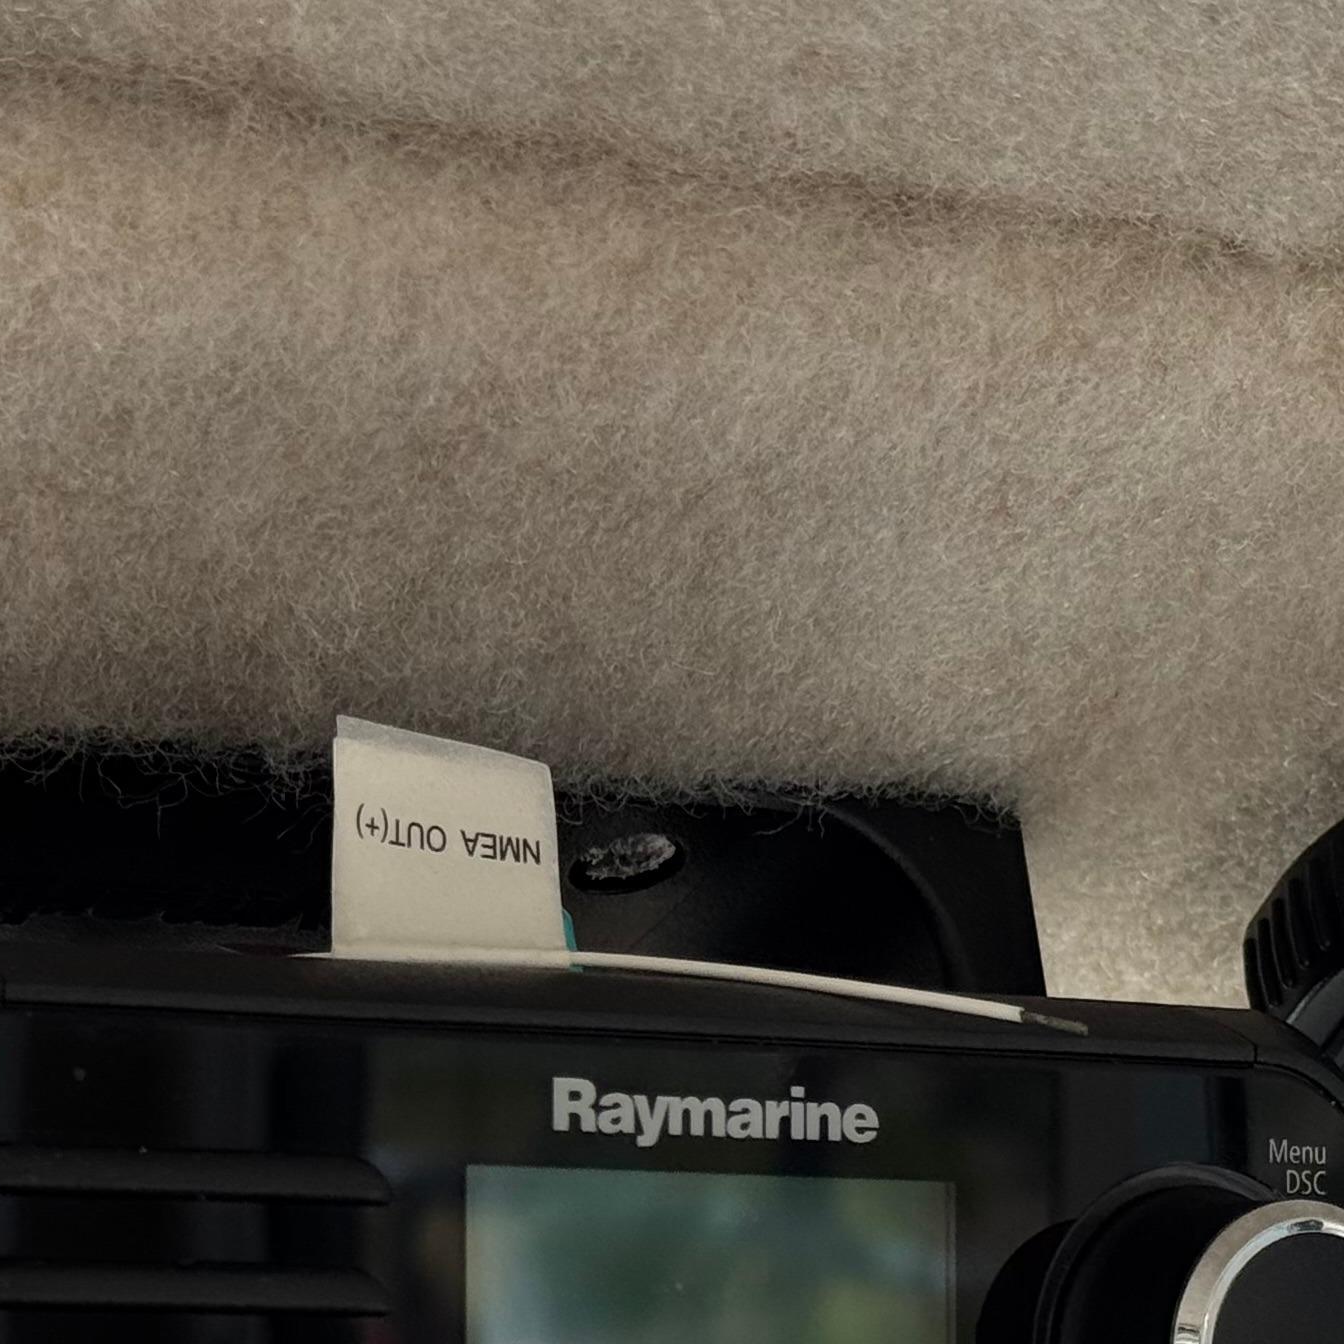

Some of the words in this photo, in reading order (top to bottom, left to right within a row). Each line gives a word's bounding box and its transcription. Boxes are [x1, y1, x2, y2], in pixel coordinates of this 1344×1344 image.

[356, 803, 447, 852] OUT(+)
[460, 830, 541, 865] NMEA
[552, 1077, 880, 1147] Raymarine
[1268, 1138, 1327, 1164] Menu
[1286, 1169, 1327, 1195] DSC
